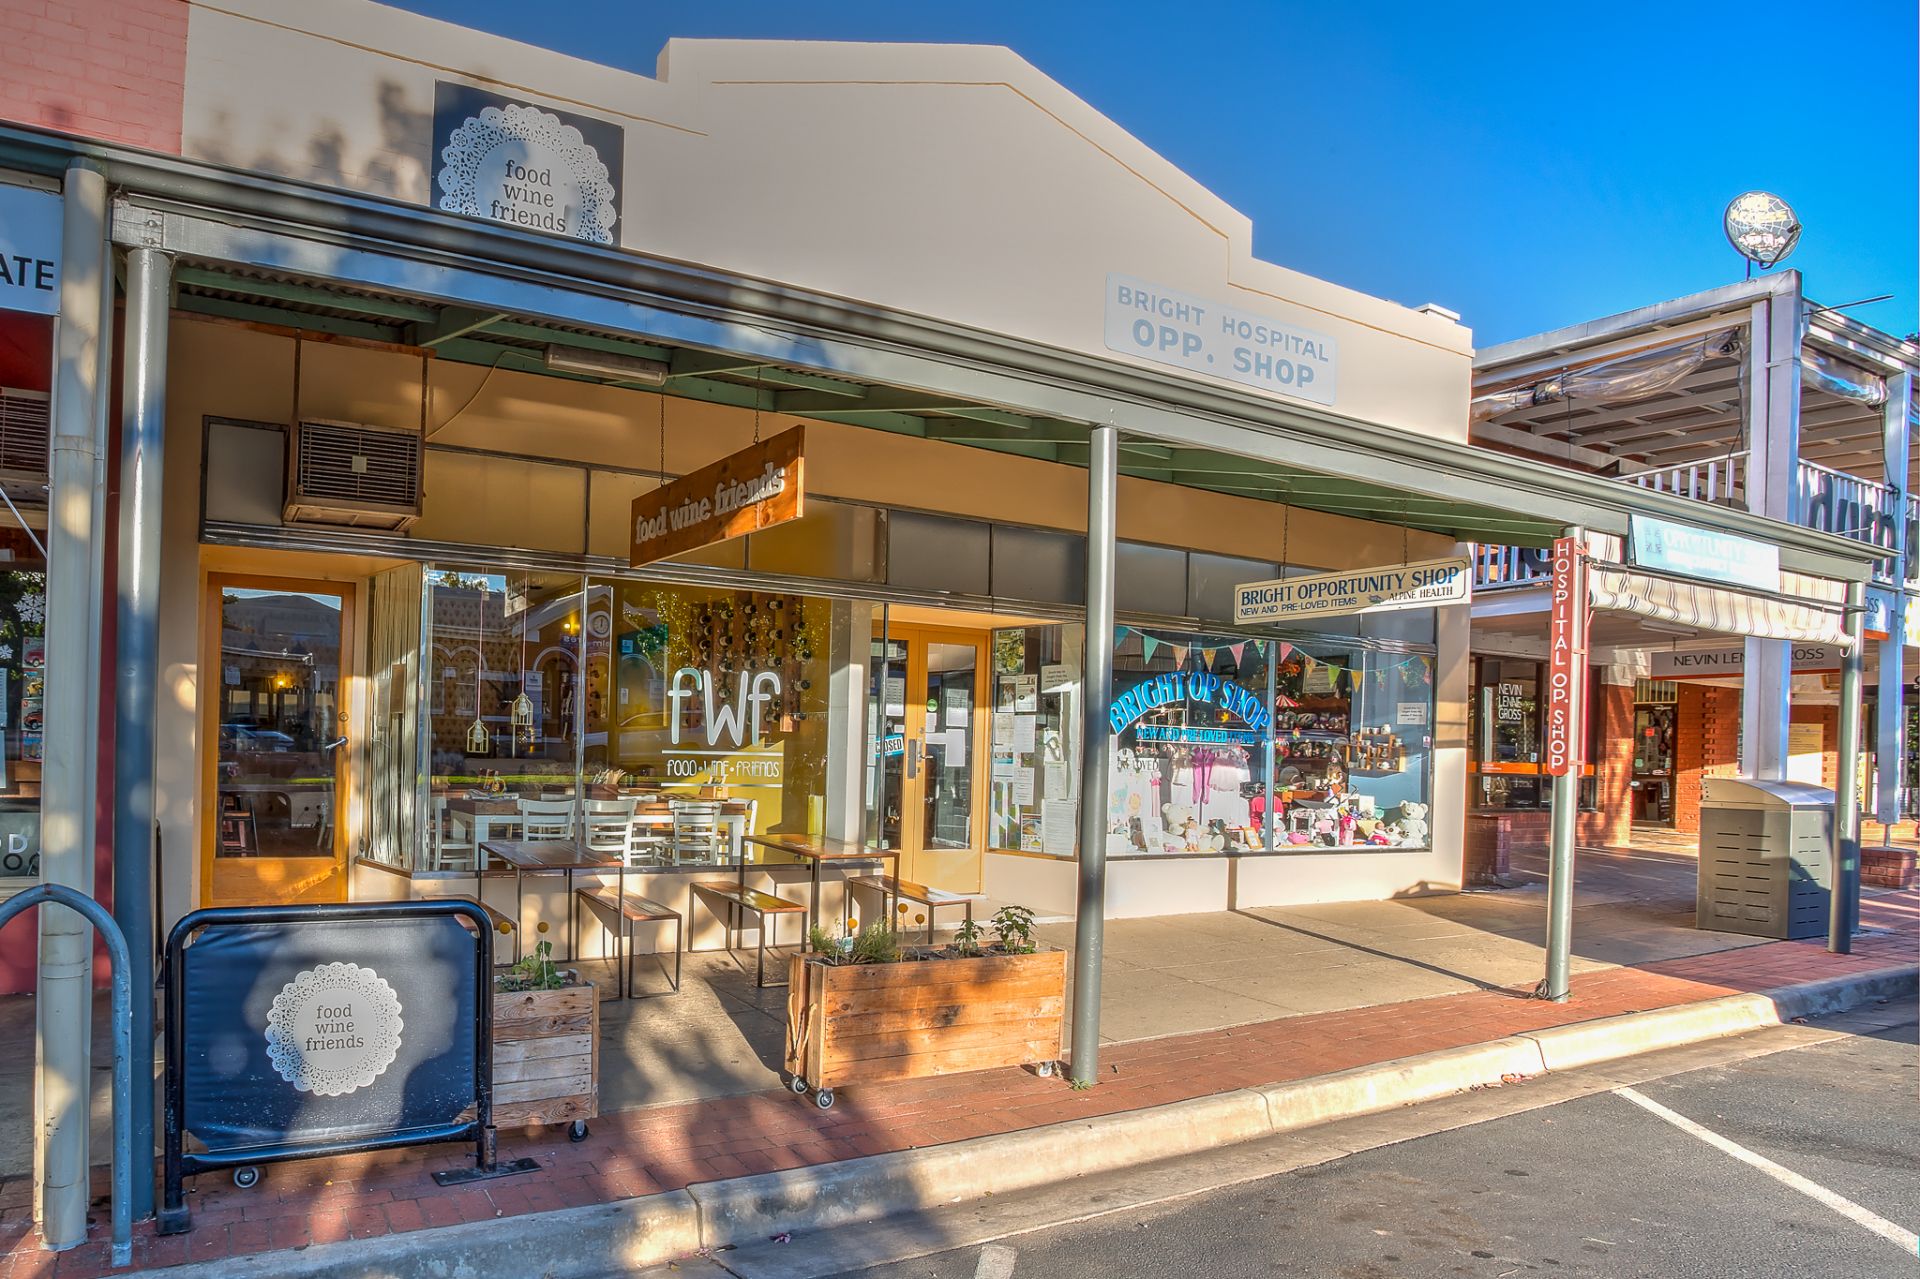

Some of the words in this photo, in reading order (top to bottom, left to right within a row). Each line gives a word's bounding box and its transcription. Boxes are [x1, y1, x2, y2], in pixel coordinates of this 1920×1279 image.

[505, 160, 552, 187] food
[503, 183, 554, 208] wine
[490, 200, 567, 232] friends
[1118, 285, 1205, 326] BRIGHT
[1222, 316, 1329, 362] HOSPITAL
[1133, 319, 1214, 364] OPP.
[1233, 347, 1314, 388] SHOP
[635, 506, 668, 545] food
[669, 496, 712, 532] wine
[714, 462, 785, 517] friends
[1241, 585, 1294, 606] BRIGHT
[1297, 572, 1407, 600] OPPORTUNITY
[1411, 566, 1460, 588] SHOP
[1389, 590, 1417, 601] ALPINE
[1420, 586, 1453, 598] HEALTH
[1240, 606, 1259, 616] NEW
[1261, 605, 1279, 614] AND
[1331, 597, 1358, 607] ITEMS
[1553, 542, 1570, 666] HOSPITAL
[1674, 653, 1719, 666] NEVIN
[1498, 683, 1523, 695] NEVIN
[1110, 671, 1187, 735] BRIGHT
[1188, 671, 1221, 703] OP
[1220, 680, 1272, 733] SHOP
[1498, 696, 1523, 708] LENNE
[1498, 708, 1522, 720] GROSS
[1136, 726, 1157, 740] NEW
[1158, 727, 1180, 741] AND
[1551, 709, 1566, 769] SHOP
[875, 738, 903, 754] COSED
[316, 1004, 352, 1019] food
[315, 1018, 355, 1034] wine
[305, 1035, 364, 1052] friends
